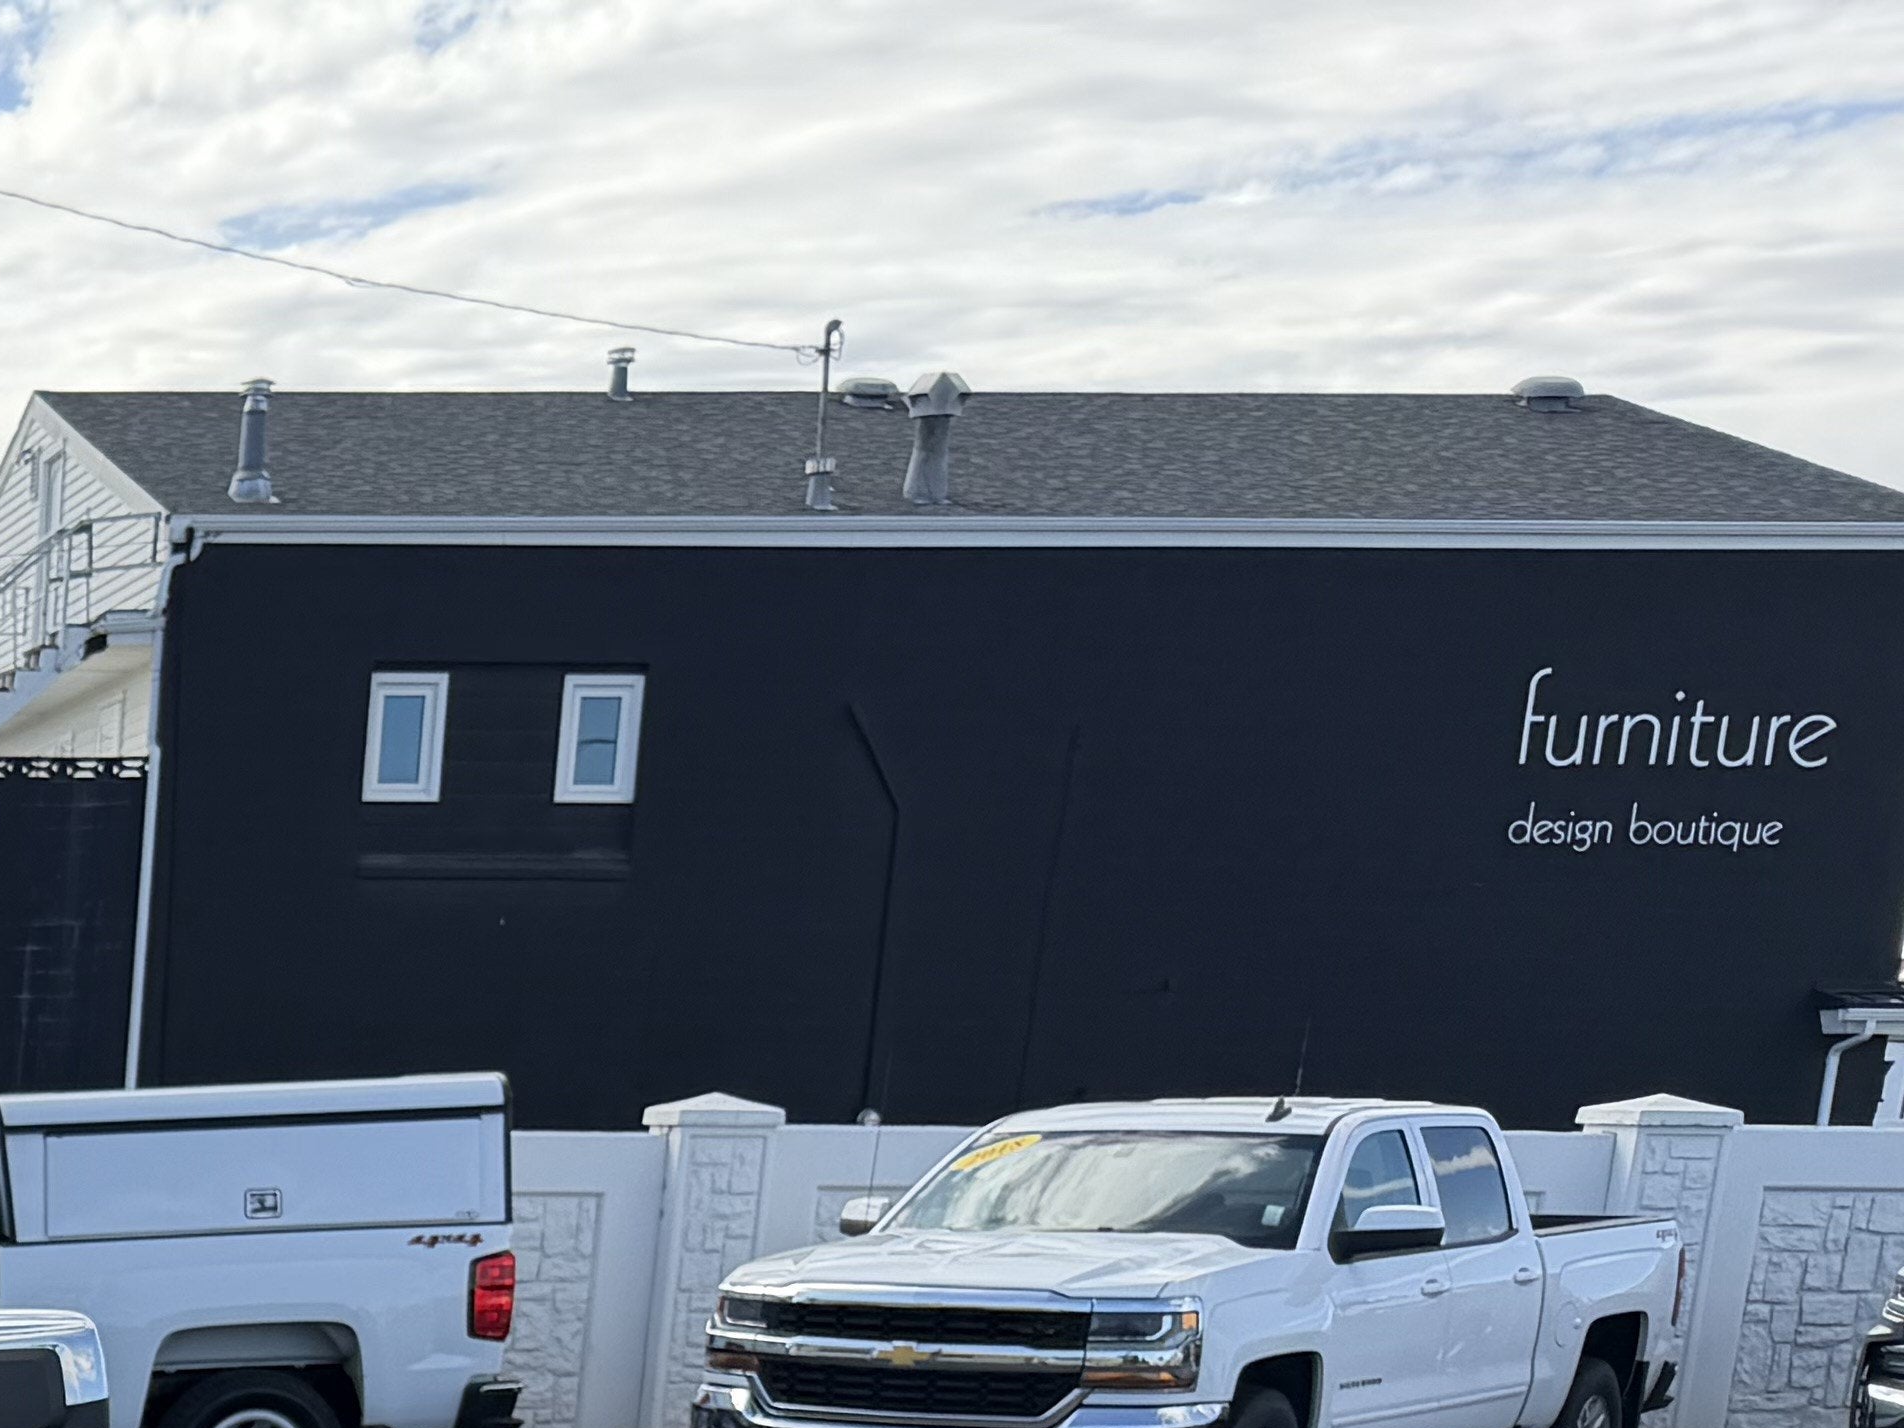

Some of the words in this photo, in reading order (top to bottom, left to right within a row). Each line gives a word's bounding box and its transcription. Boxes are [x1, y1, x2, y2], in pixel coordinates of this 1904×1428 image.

[1518, 667, 1837, 768] furniture
[1508, 801, 1613, 852] design
[1629, 802, 1784, 852] boutique
